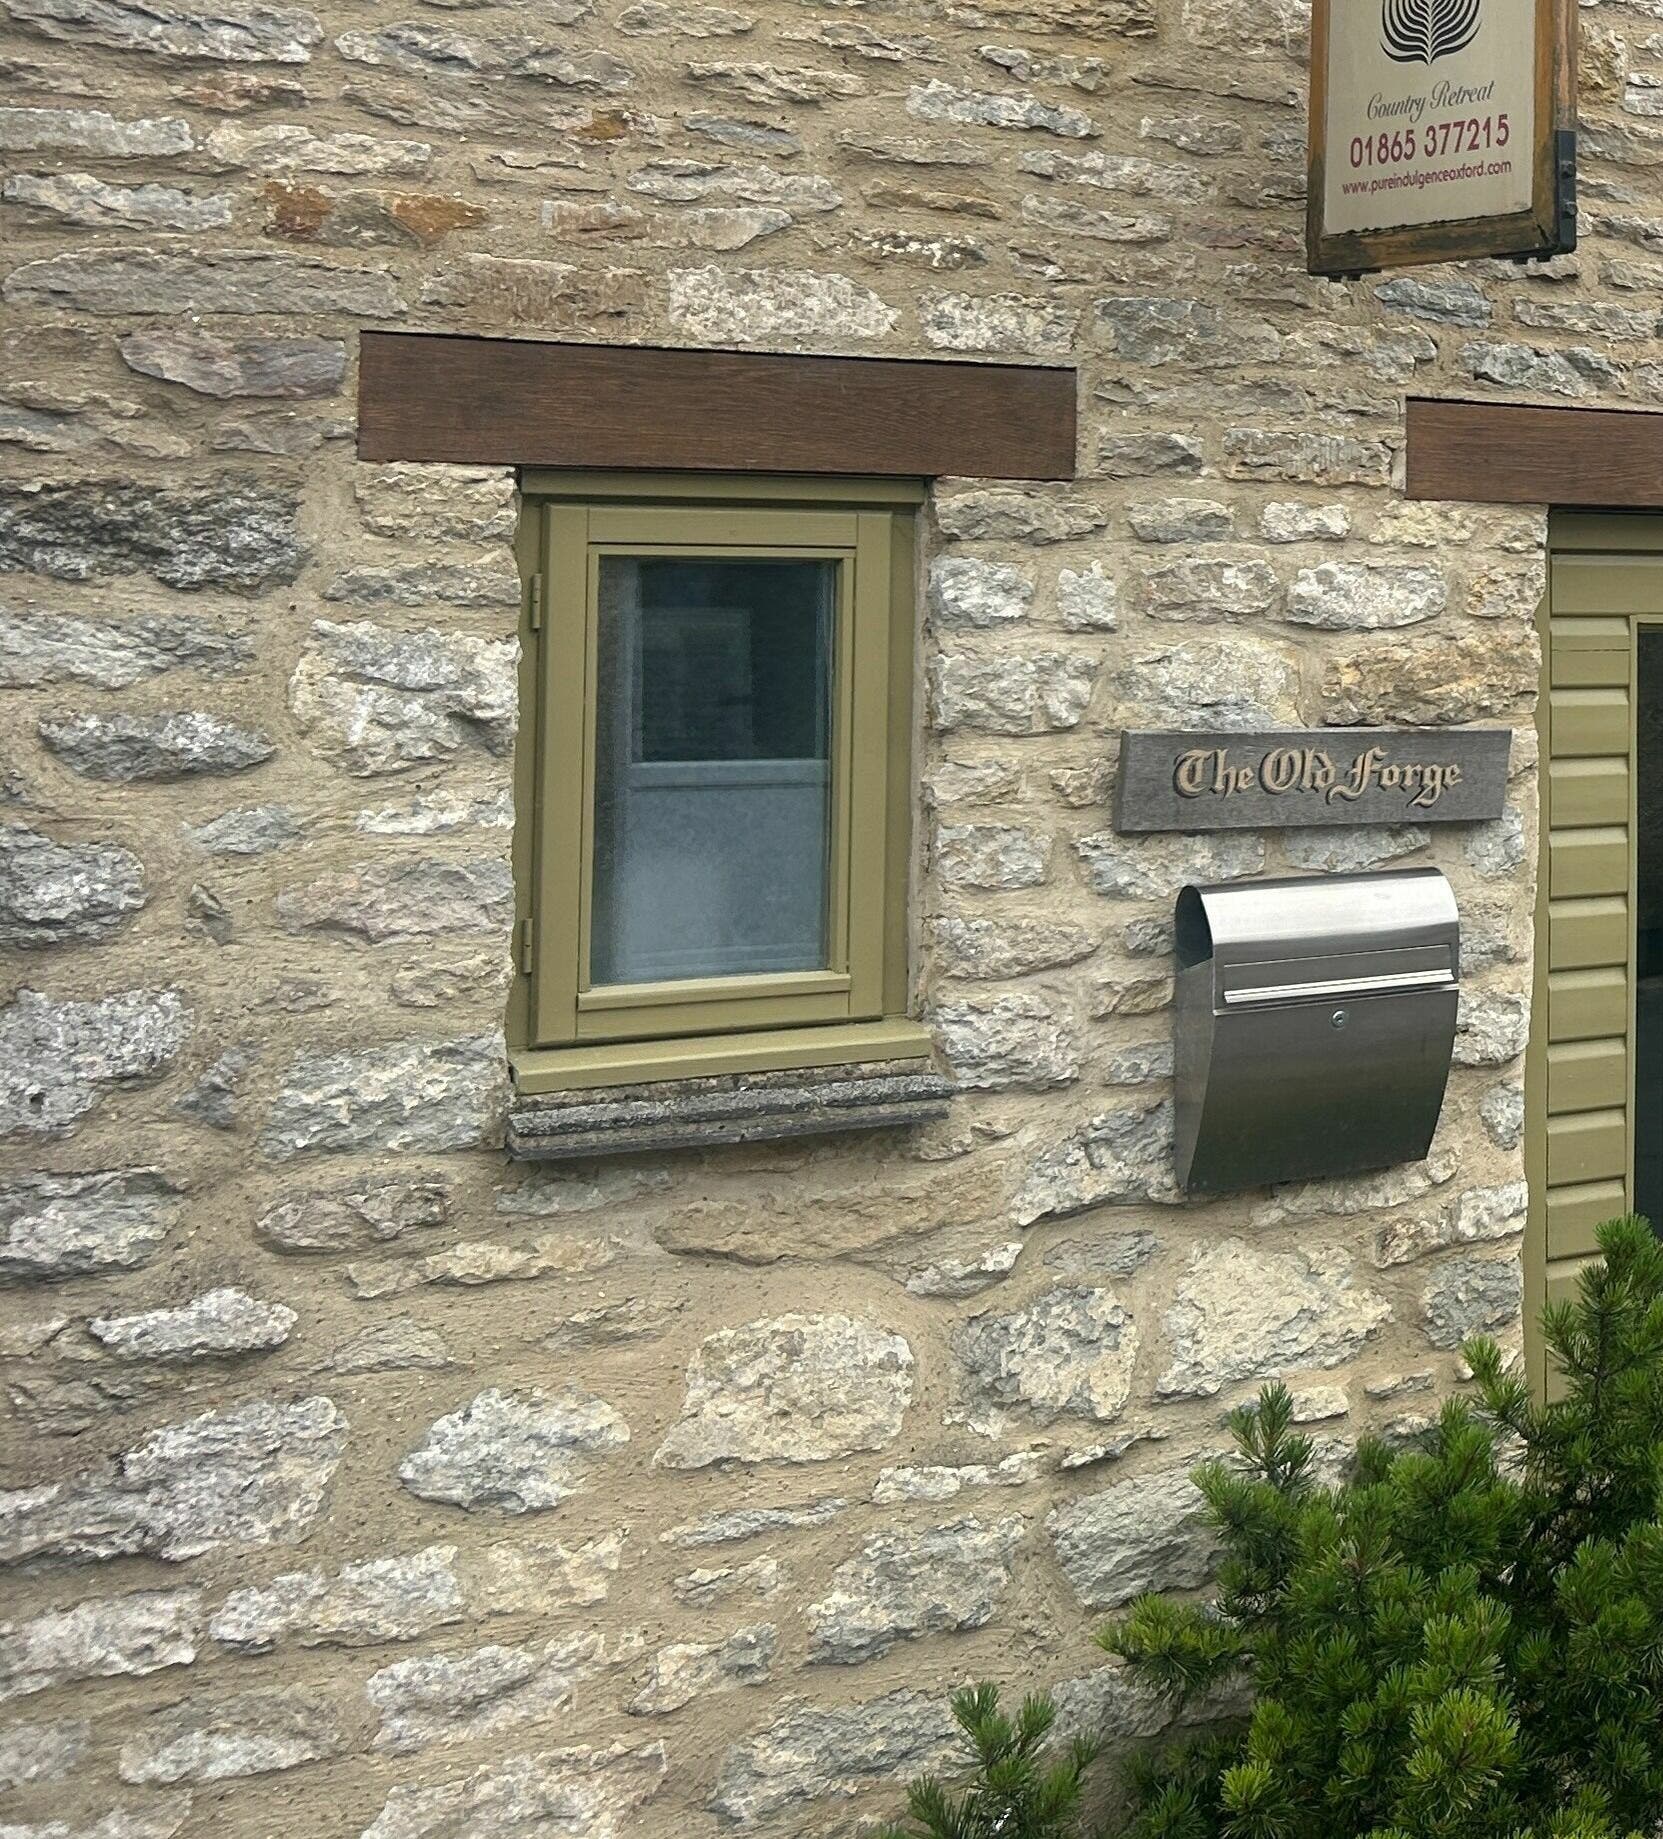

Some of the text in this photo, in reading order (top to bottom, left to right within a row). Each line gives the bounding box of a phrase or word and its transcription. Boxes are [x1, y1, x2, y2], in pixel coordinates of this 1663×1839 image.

[1367, 80, 1495, 123] Country Retreat
[1350, 114, 1510, 168] 01865 377215
[1342, 160, 1512, 194] www.pureindulgenceoxford.com
[1173, 745, 1464, 808] The Old Forge
